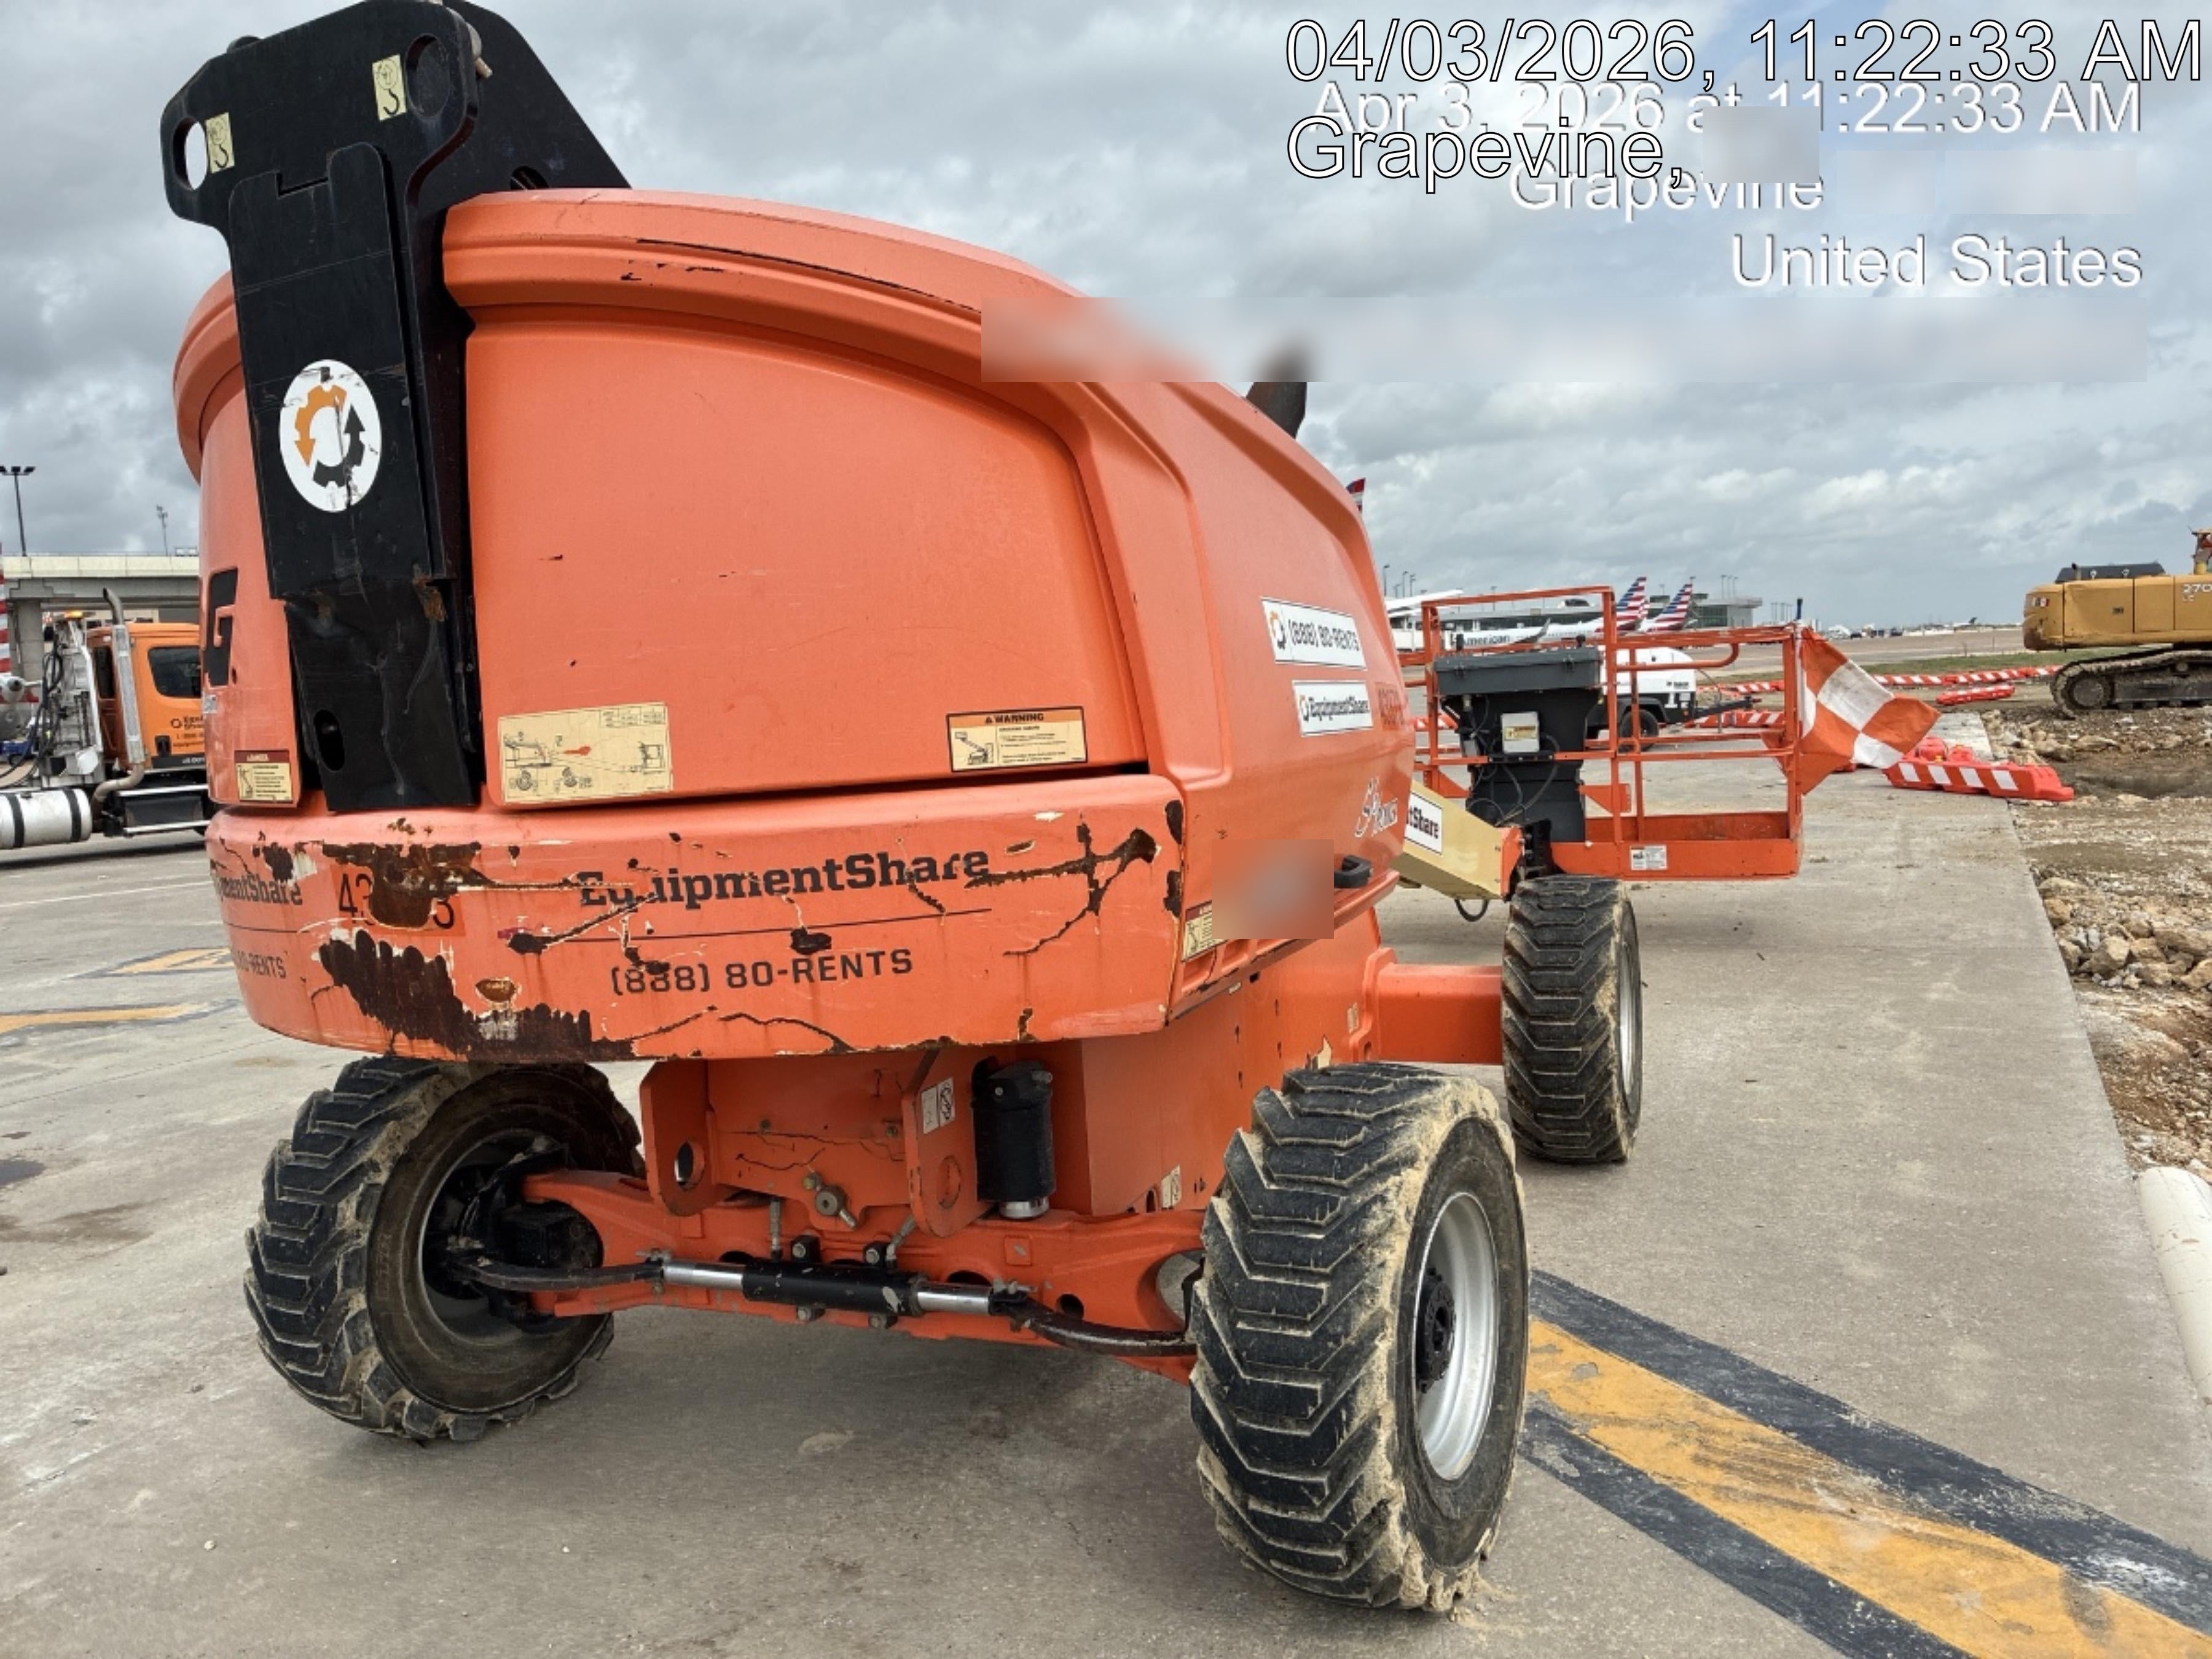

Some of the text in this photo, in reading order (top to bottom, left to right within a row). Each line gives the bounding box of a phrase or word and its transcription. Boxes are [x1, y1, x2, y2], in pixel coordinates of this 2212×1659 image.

[994, 713, 1045, 723] WARNING
[611, 949, 913, 996] (888) 80-RENTS
